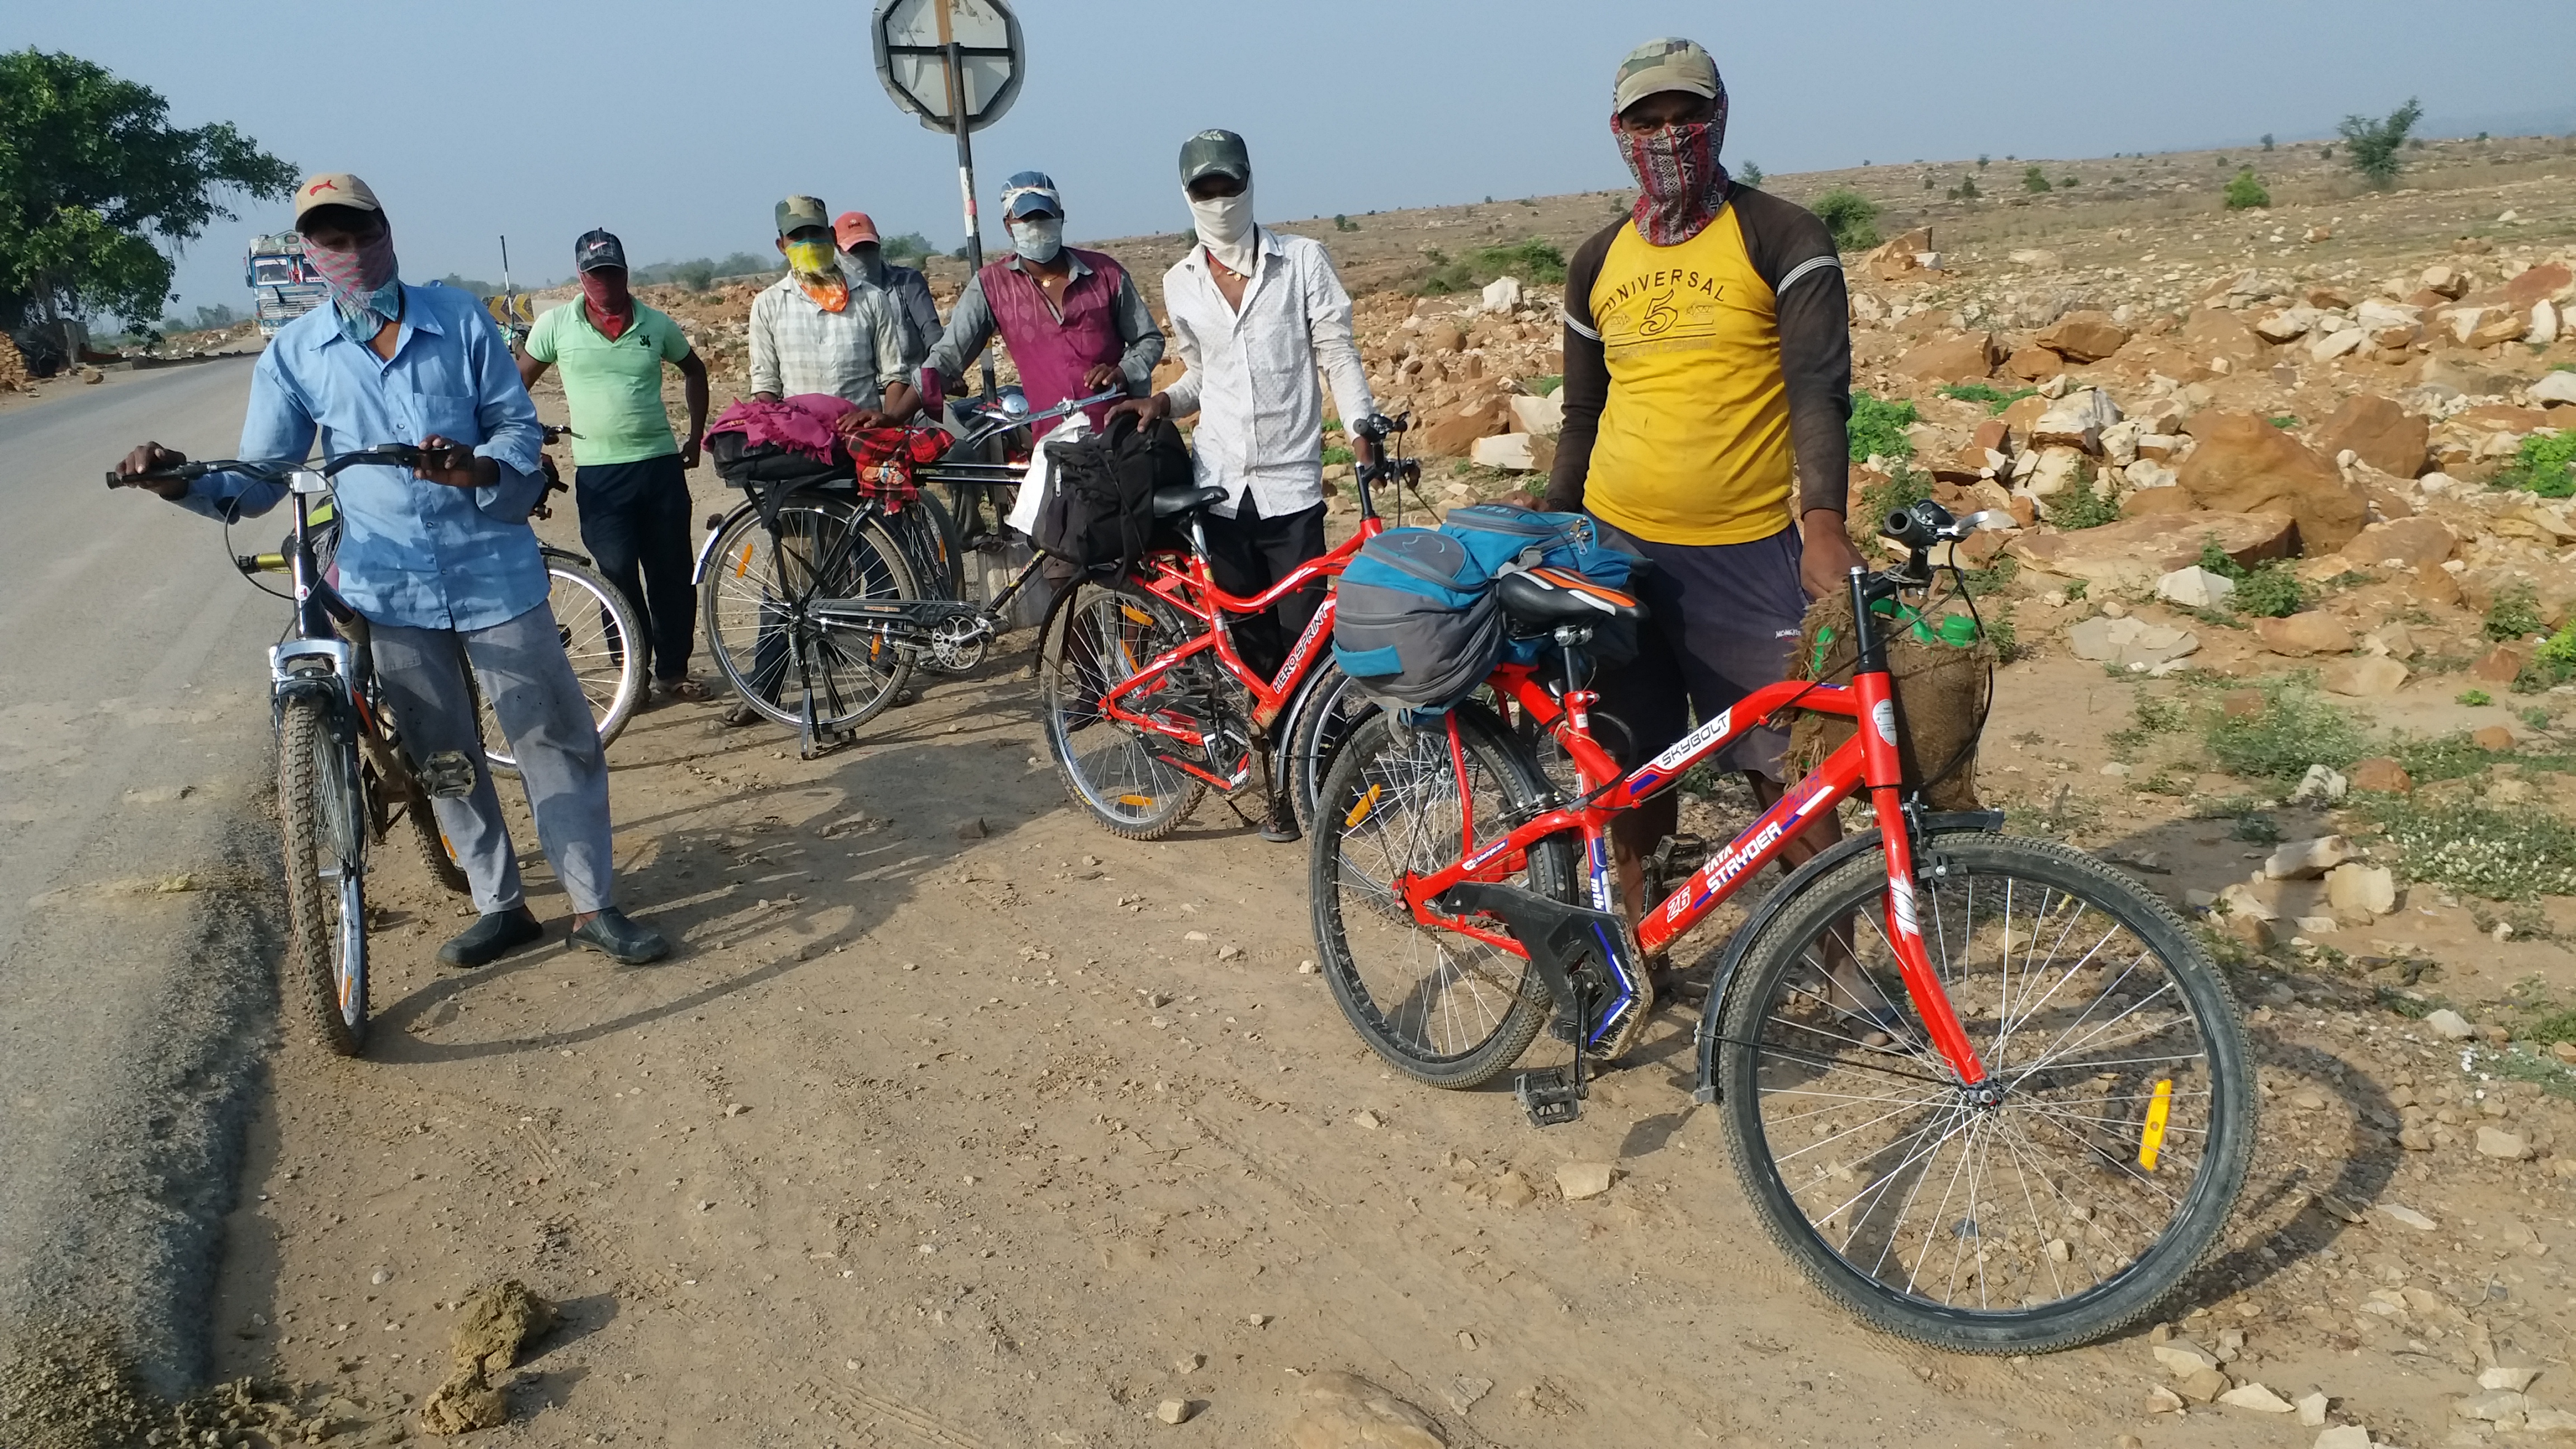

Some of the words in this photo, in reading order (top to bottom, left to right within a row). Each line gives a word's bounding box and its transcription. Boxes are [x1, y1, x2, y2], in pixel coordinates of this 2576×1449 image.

[1604, 269, 1724, 311] UNIVERSAL
[1639, 288, 1678, 336] 5
[1273, 655, 1297, 693] HERO
[1295, 604, 1327, 661] SPRINT
[1662, 714, 1727, 766] SKYBOLT
[1702, 844, 1734, 876] TATA
[1706, 821, 1782, 894] STRYDER
[1590, 878, 1604, 910] mtb
[1666, 886, 1691, 924] 26
